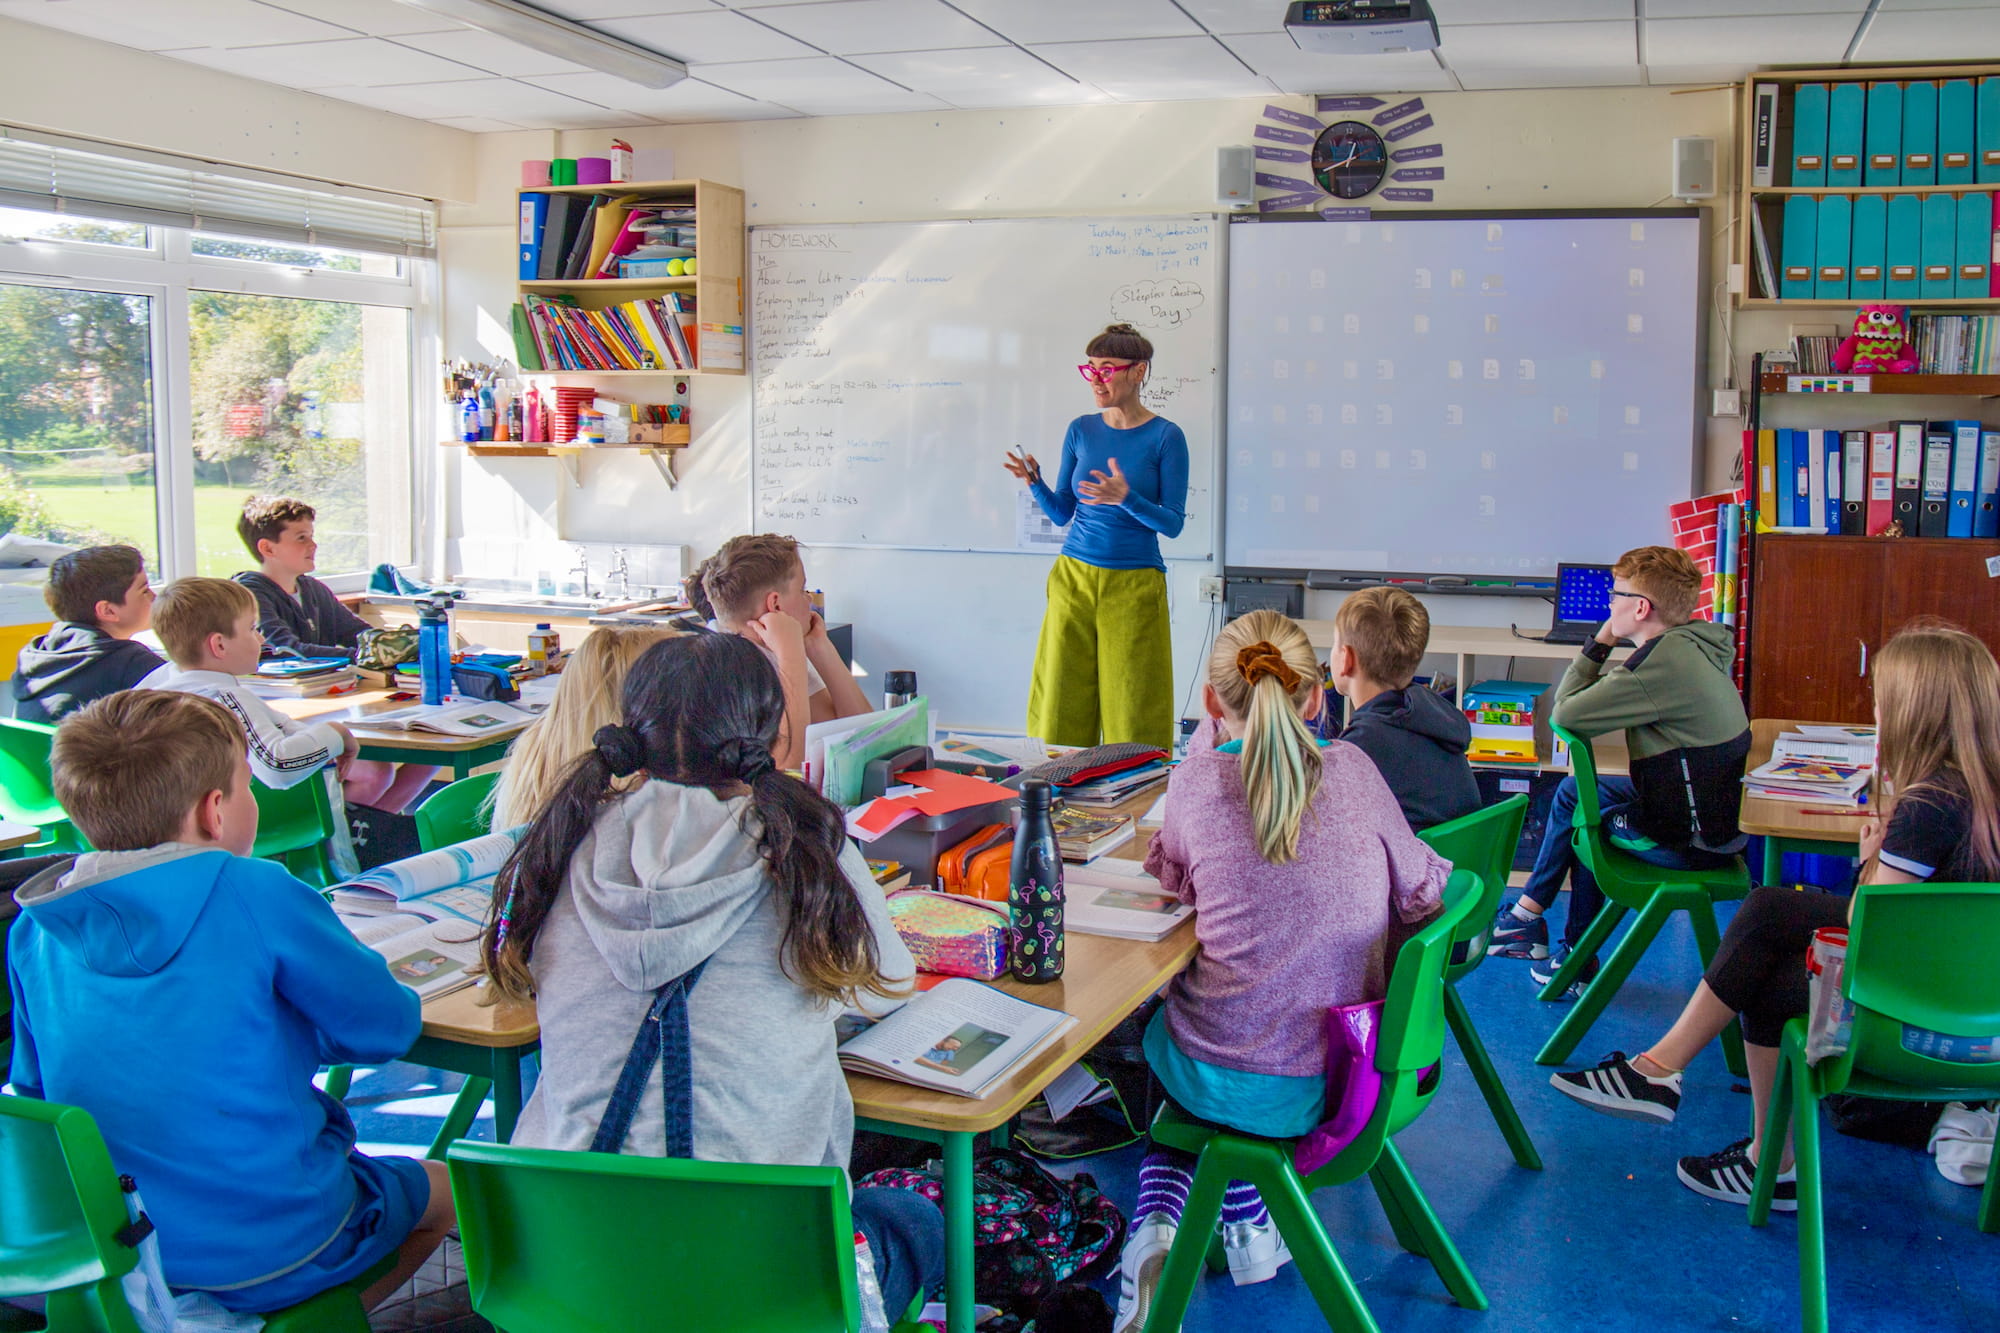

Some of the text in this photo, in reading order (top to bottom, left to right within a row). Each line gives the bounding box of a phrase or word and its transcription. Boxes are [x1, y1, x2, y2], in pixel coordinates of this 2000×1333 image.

[1759, 122, 1768, 147] RANG
[1186, 225, 1209, 236] 2019
[760, 232, 839, 249] HOMEWORK
[1184, 240, 1209, 251] 2019
[758, 255, 776, 267] Mon
[755, 291, 793, 310] Exploring
[797, 289, 825, 308] spelling
[832, 293, 844, 308] pg
[782, 309, 808, 325] spelling
[1150, 305, 1181, 325] Day
[758, 410, 777, 424] Wed
